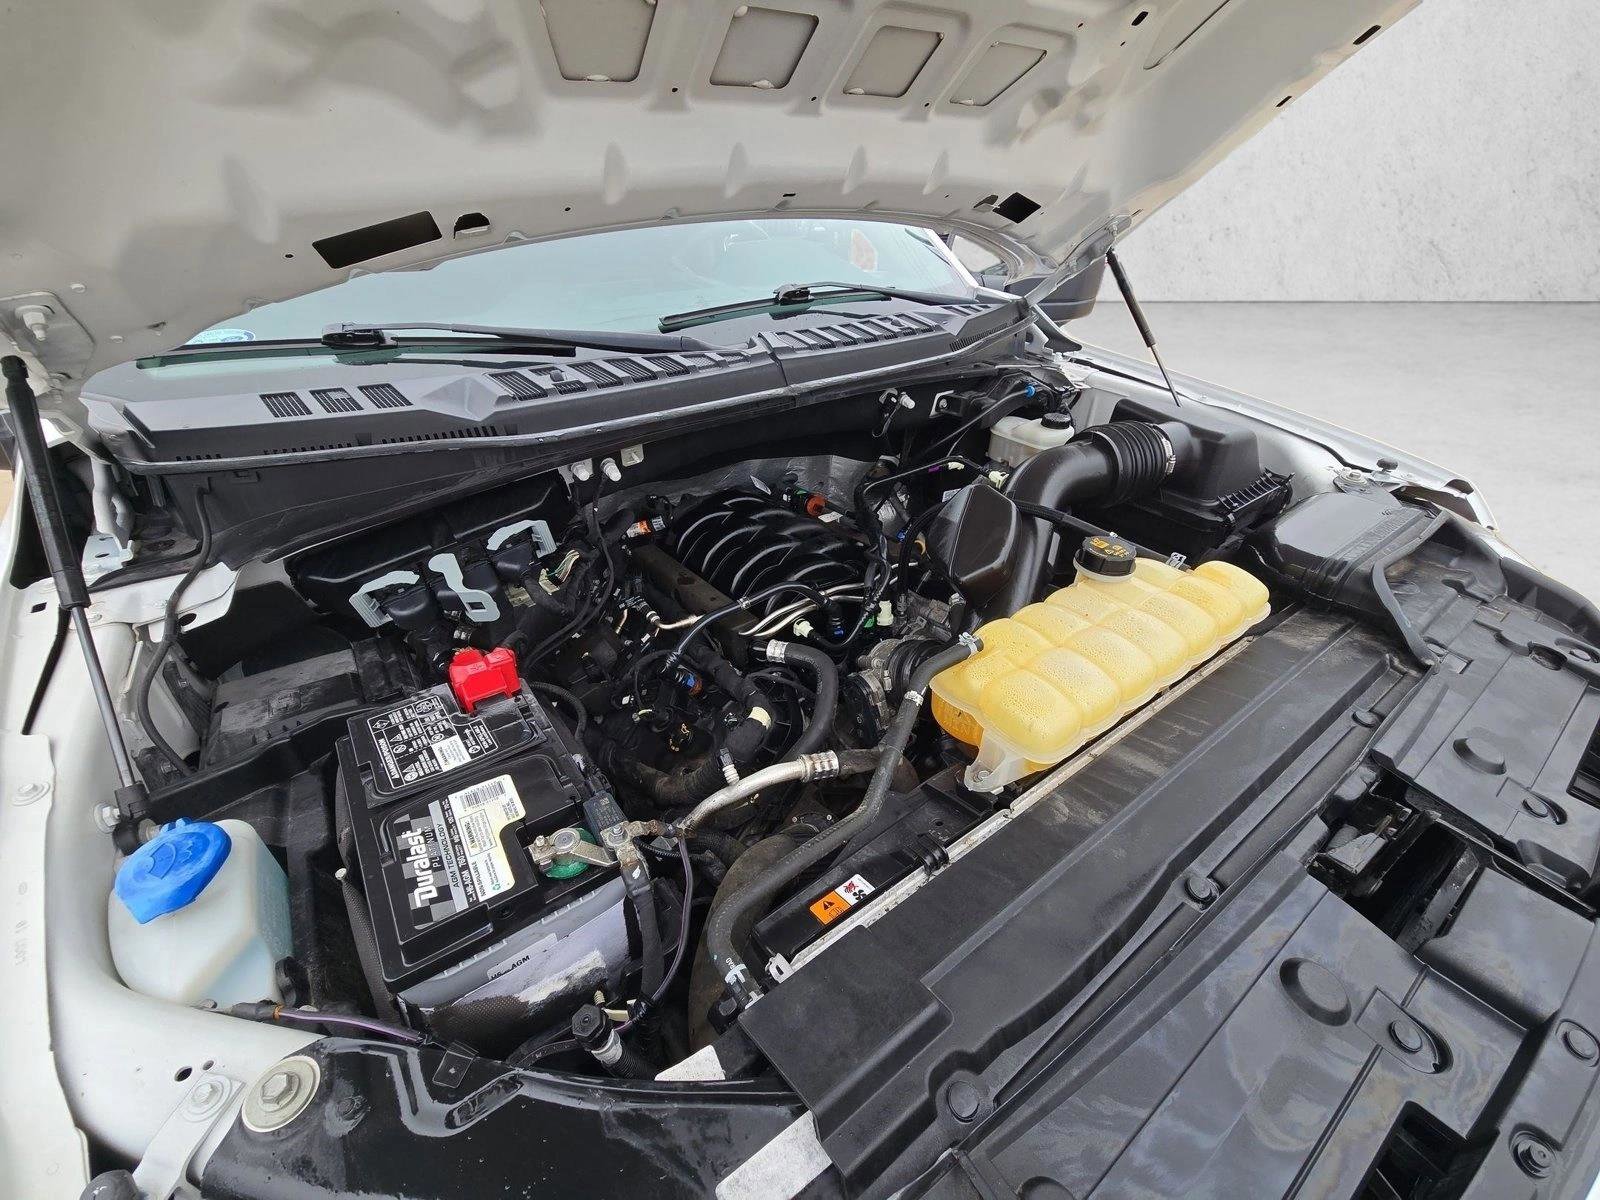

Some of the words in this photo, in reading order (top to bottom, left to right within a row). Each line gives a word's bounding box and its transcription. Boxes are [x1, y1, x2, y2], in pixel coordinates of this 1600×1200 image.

[401, 828, 438, 908] Duralast
[424, 825, 441, 868] PLATINUM
[437, 823, 455, 869] TECHNOLOGY
[450, 871, 460, 888] AGM
